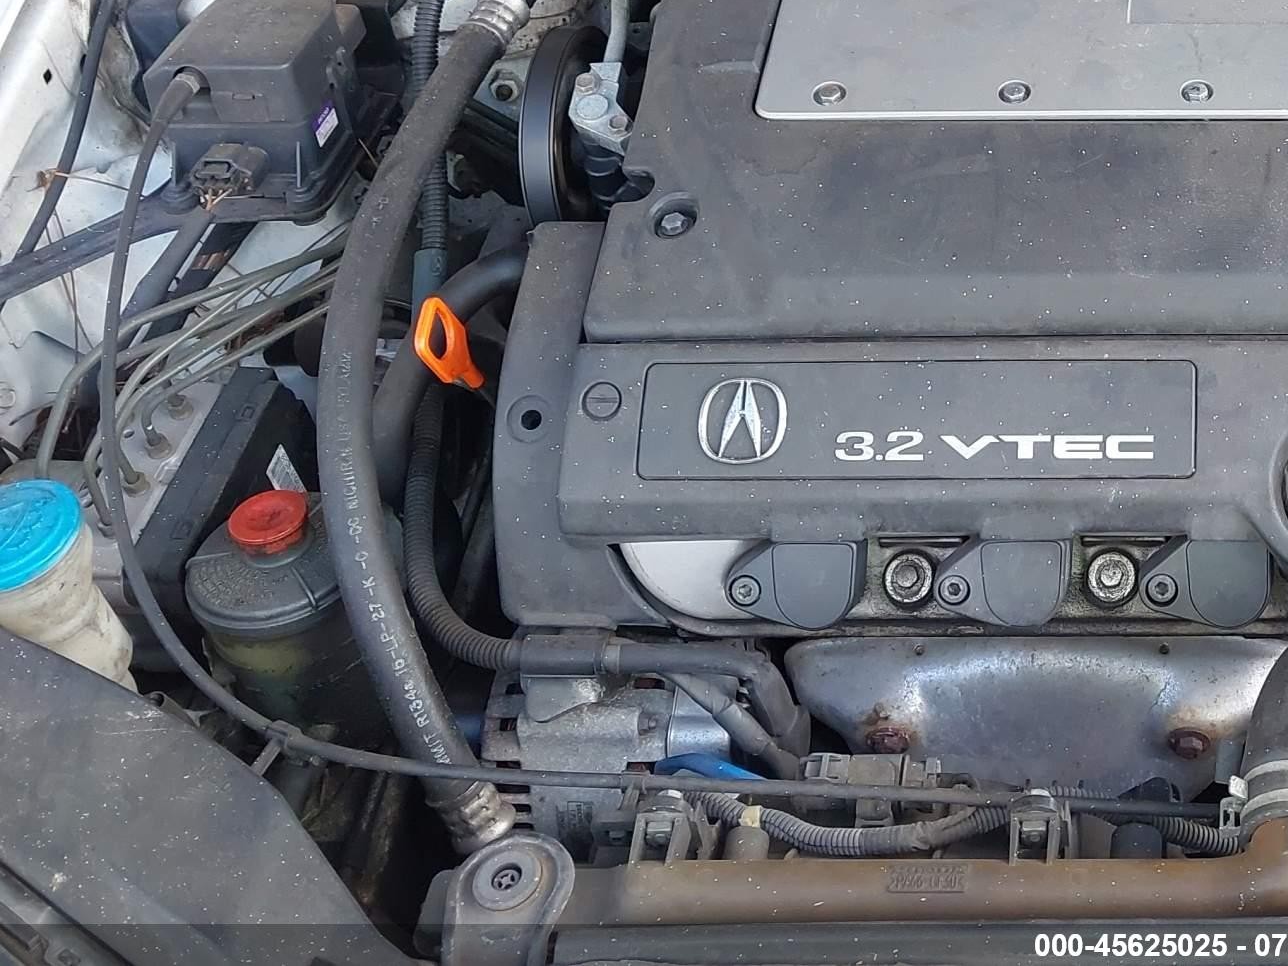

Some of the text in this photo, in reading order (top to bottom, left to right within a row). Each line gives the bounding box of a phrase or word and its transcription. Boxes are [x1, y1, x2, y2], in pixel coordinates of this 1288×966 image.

[834, 431, 1154, 463] 3.2 VTEC
[403, 679, 430, 728] R134a
